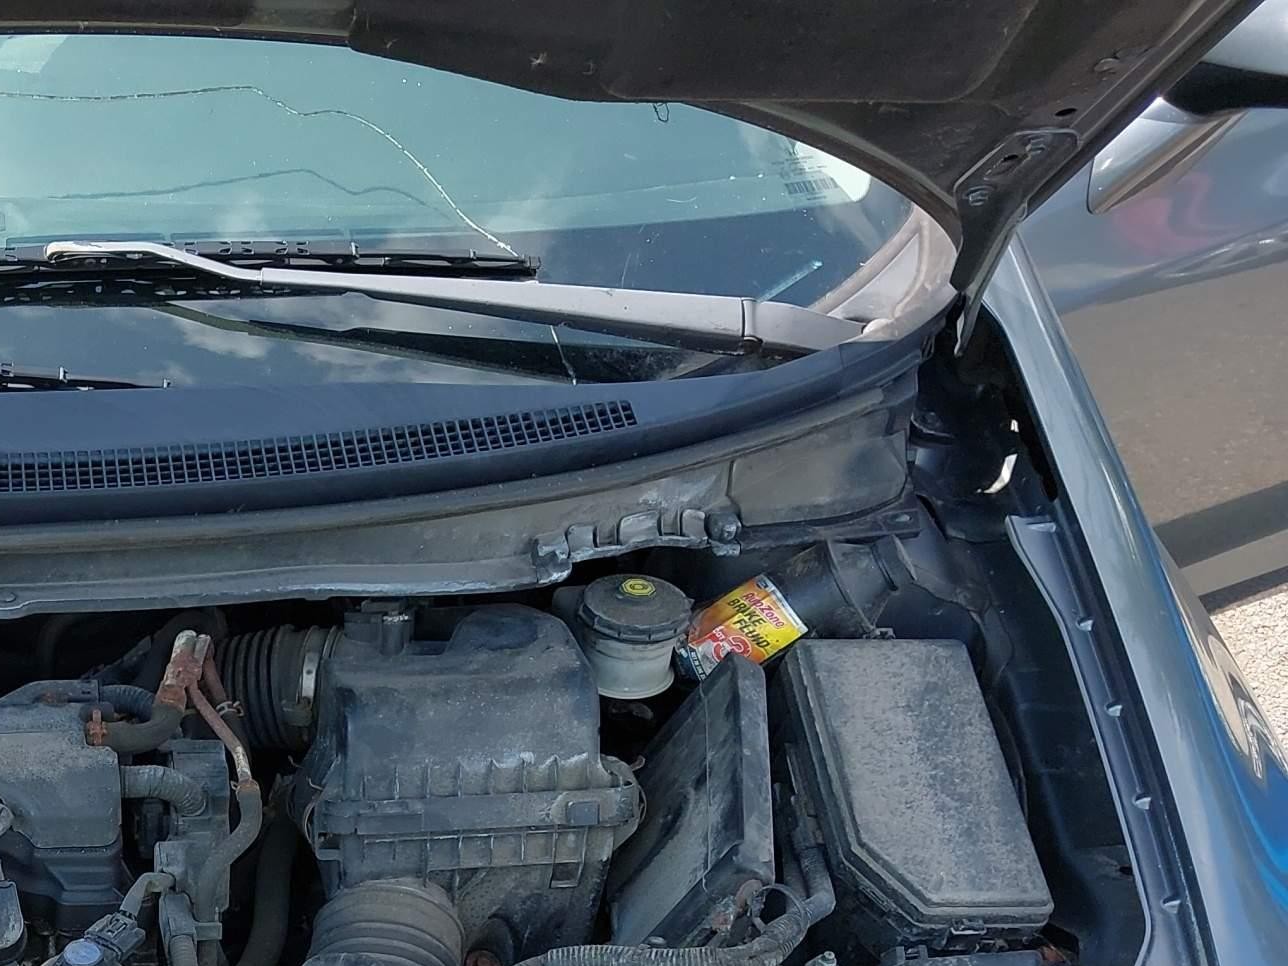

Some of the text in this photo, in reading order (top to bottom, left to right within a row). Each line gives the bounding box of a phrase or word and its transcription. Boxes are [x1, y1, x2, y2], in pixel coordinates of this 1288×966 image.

[728, 599, 767, 627] BRAKE
[742, 592, 785, 628] AutoZone
[733, 619, 770, 649] FLUID
